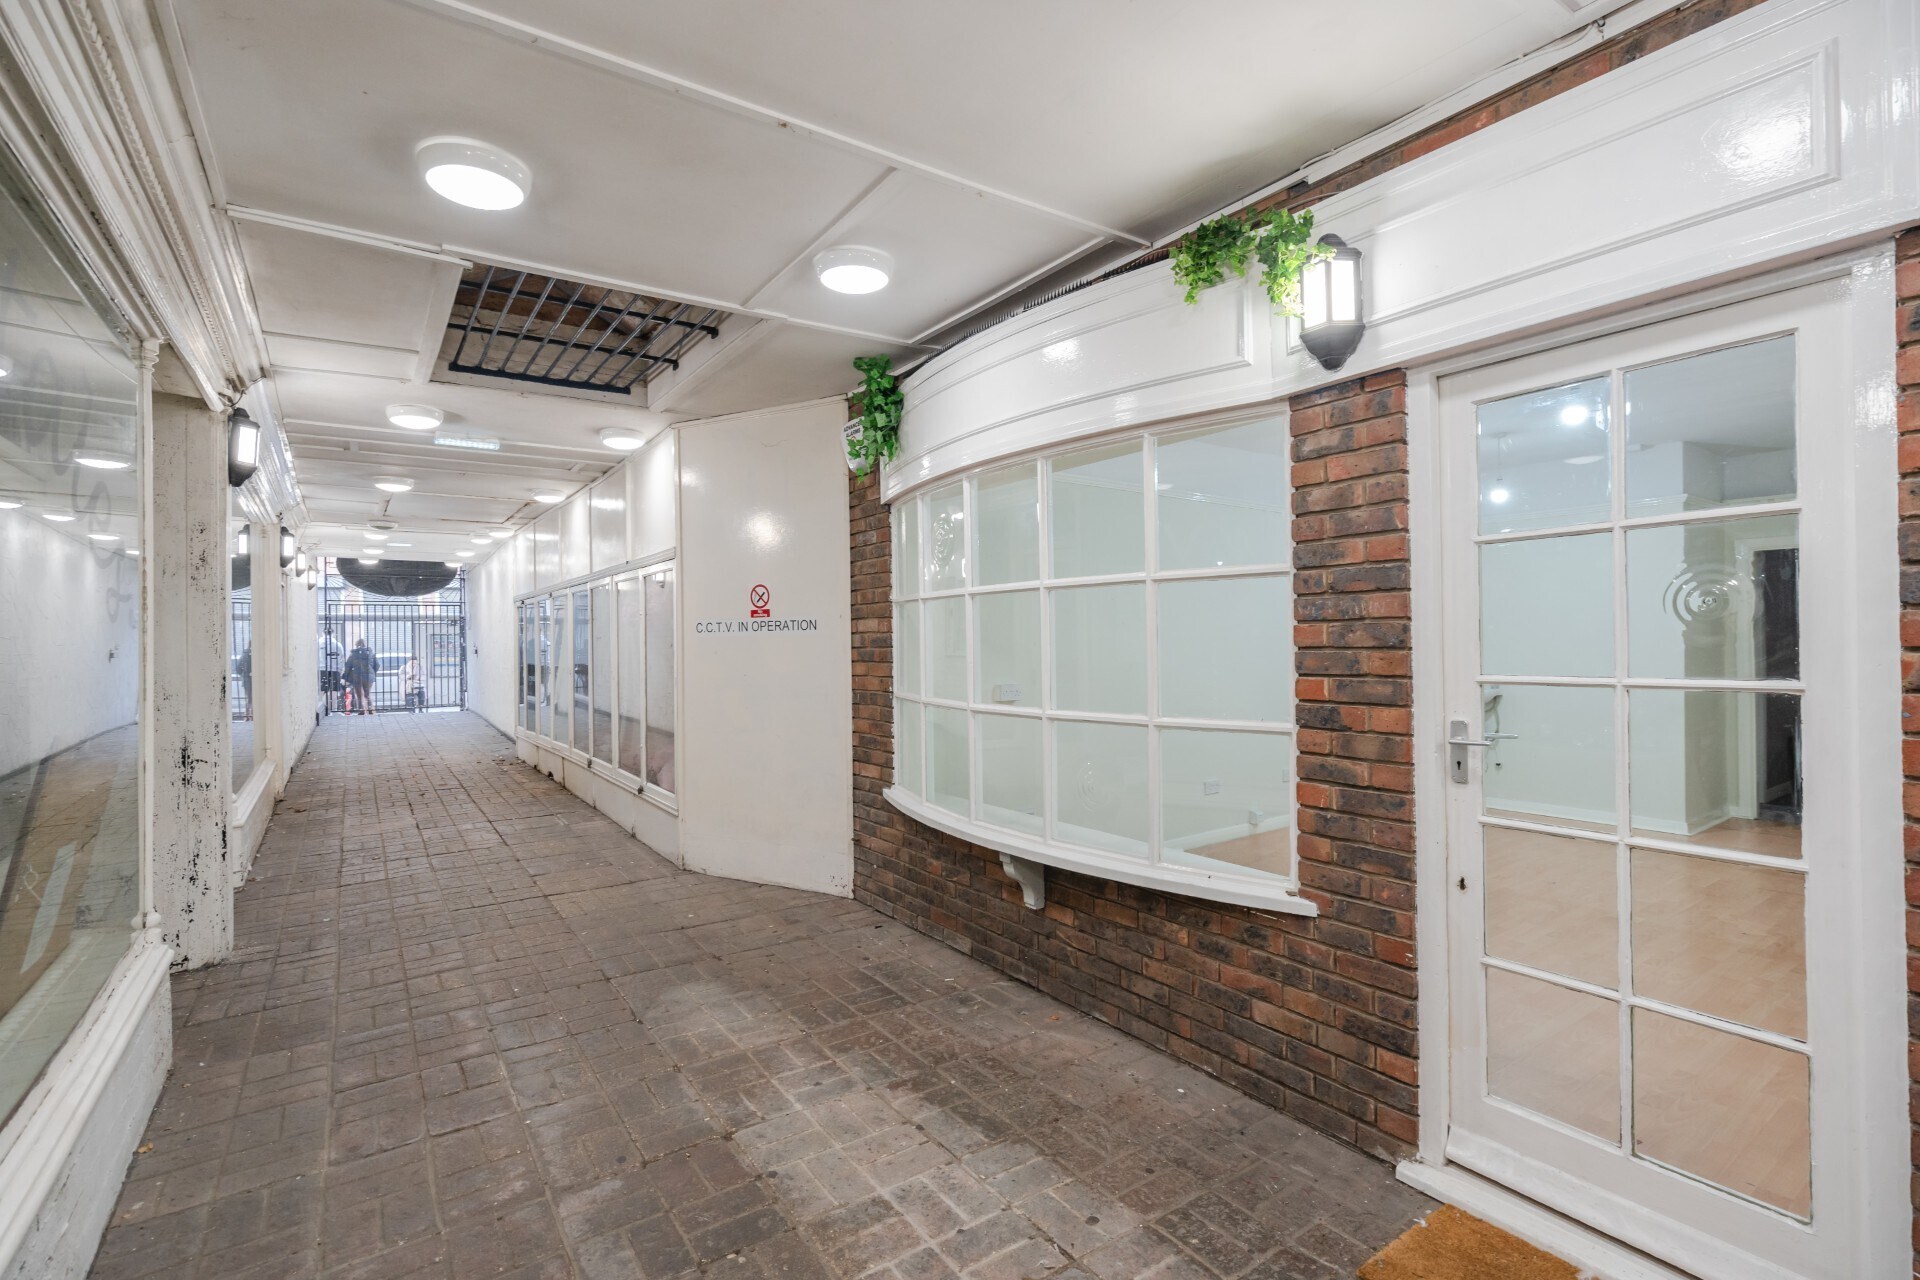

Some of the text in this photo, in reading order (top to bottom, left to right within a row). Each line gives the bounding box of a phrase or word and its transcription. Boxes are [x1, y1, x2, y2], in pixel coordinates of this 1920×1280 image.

[696, 619, 817, 633] C.C.T.V. IN OPERATION
